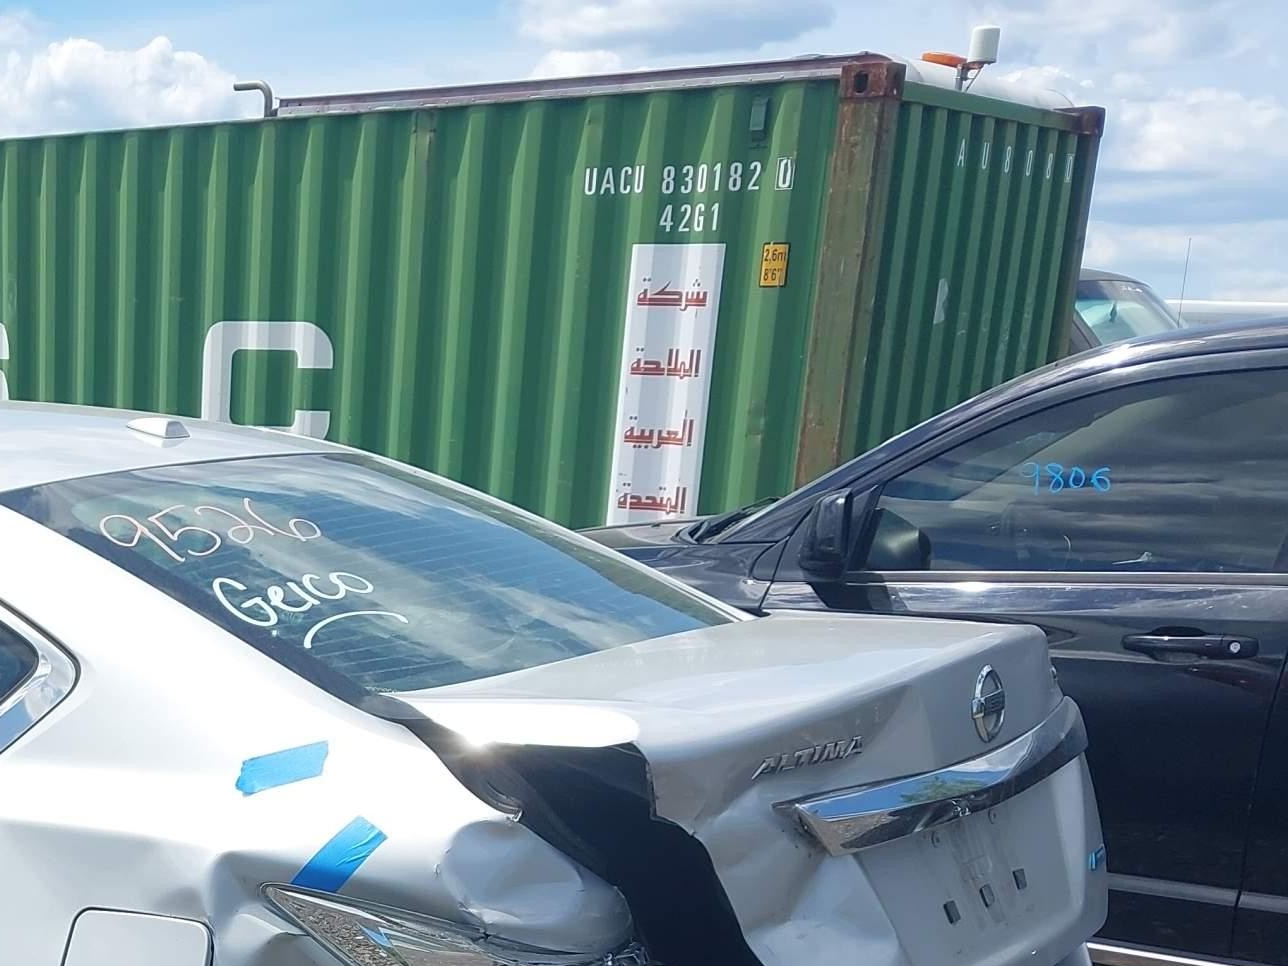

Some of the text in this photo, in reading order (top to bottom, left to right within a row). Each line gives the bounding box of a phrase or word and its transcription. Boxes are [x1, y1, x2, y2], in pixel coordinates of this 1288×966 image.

[584, 165, 645, 195] UACU
[662, 161, 761, 194] 830182
[660, 203, 720, 232] 42G1
[637, 279, 708, 311] شركة
[630, 347, 701, 379] الملاحة
[623, 415, 694, 449] العربية
[1020, 462, 1111, 496] 9806
[616, 482, 687, 515] المتحدة
[99, 497, 322, 563] 9526
[751, 735, 863, 780] ALTIMA
